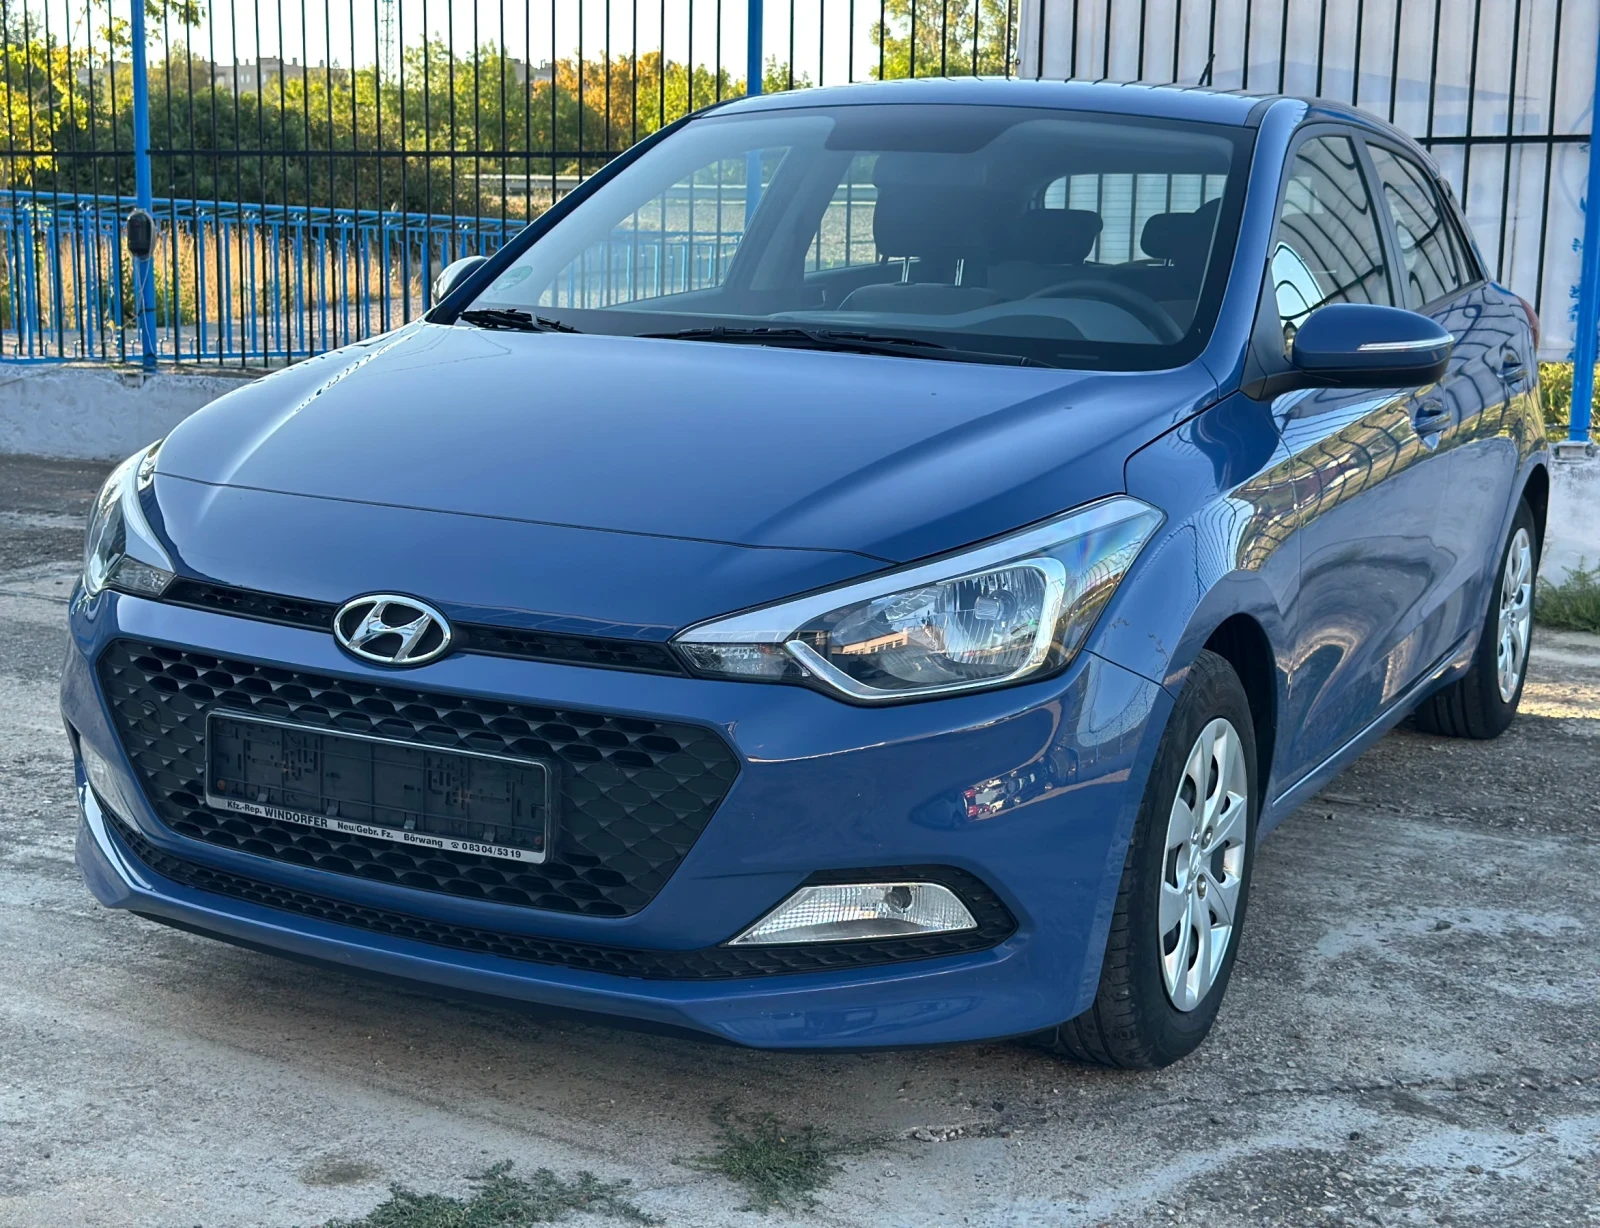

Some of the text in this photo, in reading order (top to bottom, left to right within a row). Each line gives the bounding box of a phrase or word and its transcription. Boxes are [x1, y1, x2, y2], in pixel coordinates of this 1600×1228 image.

[227, 800, 262, 815] Kfz.-Rep.
[264, 807, 328, 828] WINDORFER
[337, 821, 379, 836] Neu/Gebr.
[404, 833, 443, 848] Börwang
